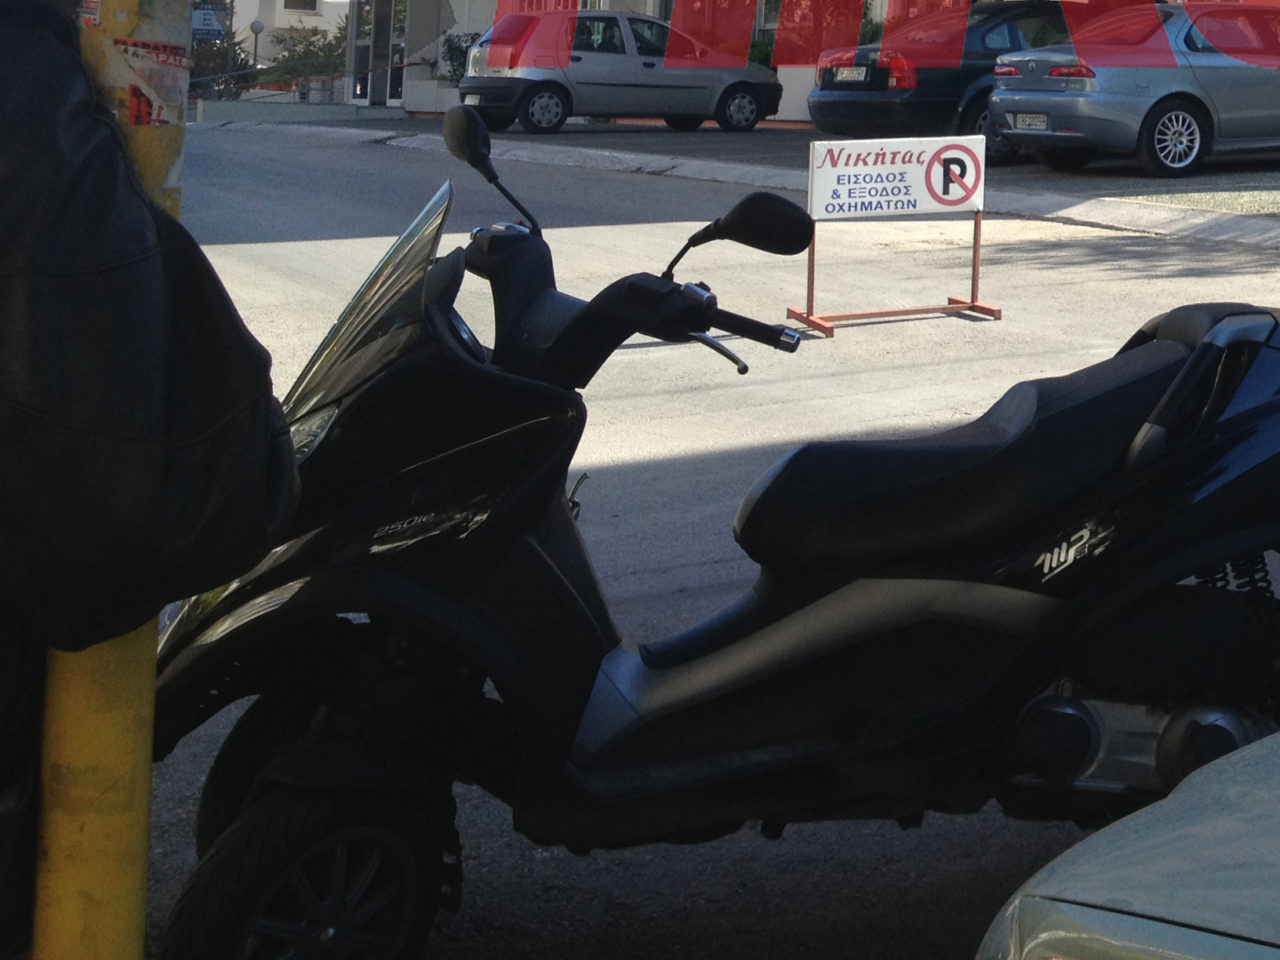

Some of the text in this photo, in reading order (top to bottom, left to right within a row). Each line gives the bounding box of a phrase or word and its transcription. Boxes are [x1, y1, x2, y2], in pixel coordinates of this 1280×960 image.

[816, 147, 927, 169] Νικήτας
[836, 171, 908, 186] ΕΙΣΟΔΟΣ
[831, 185, 912, 200] & ΕΞΟΔΟΣ
[824, 198, 918, 214] ΟΧΗΜΑΤΩΝ
